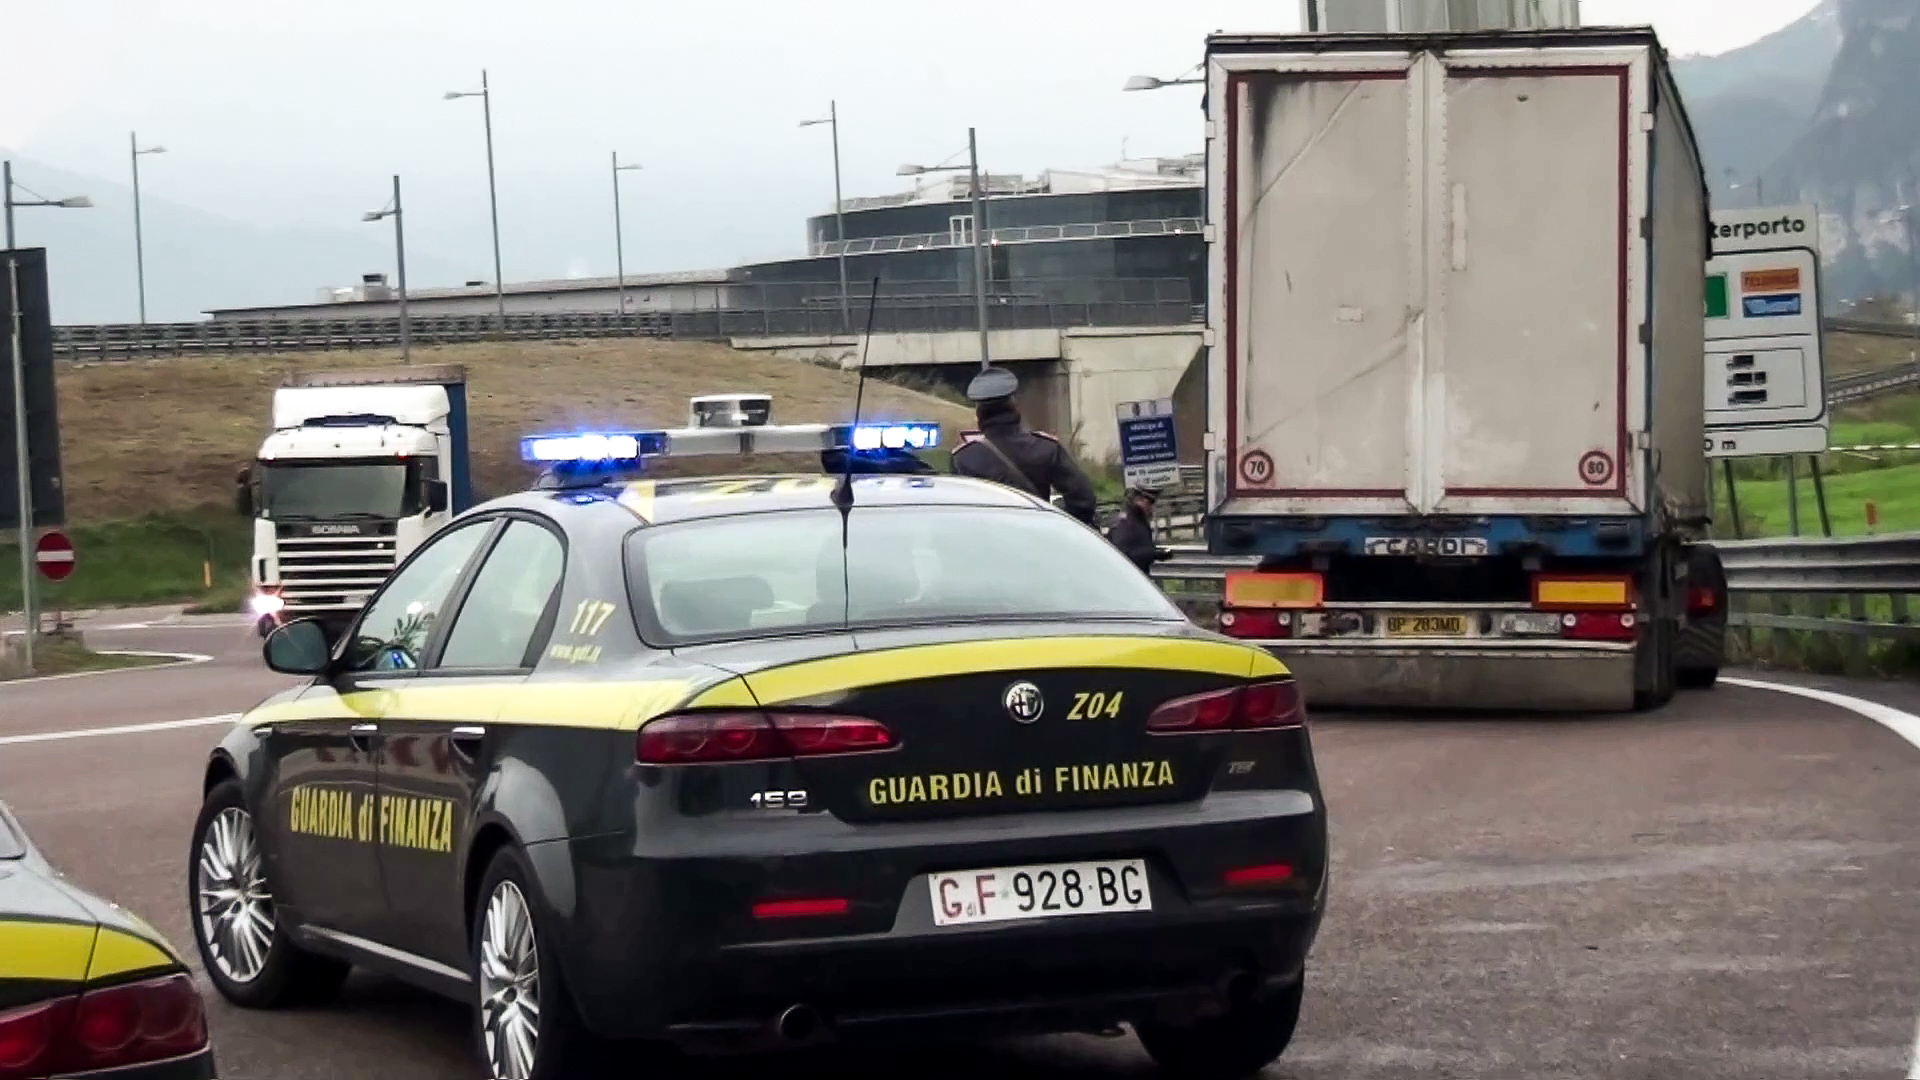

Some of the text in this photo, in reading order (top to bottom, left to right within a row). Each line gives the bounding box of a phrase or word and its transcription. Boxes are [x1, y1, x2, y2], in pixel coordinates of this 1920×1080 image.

[1250, 461, 1265, 475] 70
[1588, 461, 1604, 475] 80
[569, 600, 616, 635] 117
[750, 790, 807, 808] 159
[869, 760, 1174, 805] GUARDIA di FINANZA
[290, 786, 452, 853] GUARDIA di FINANZA
[1013, 868, 1084, 911] 928
[1096, 865, 1142, 906] BG
